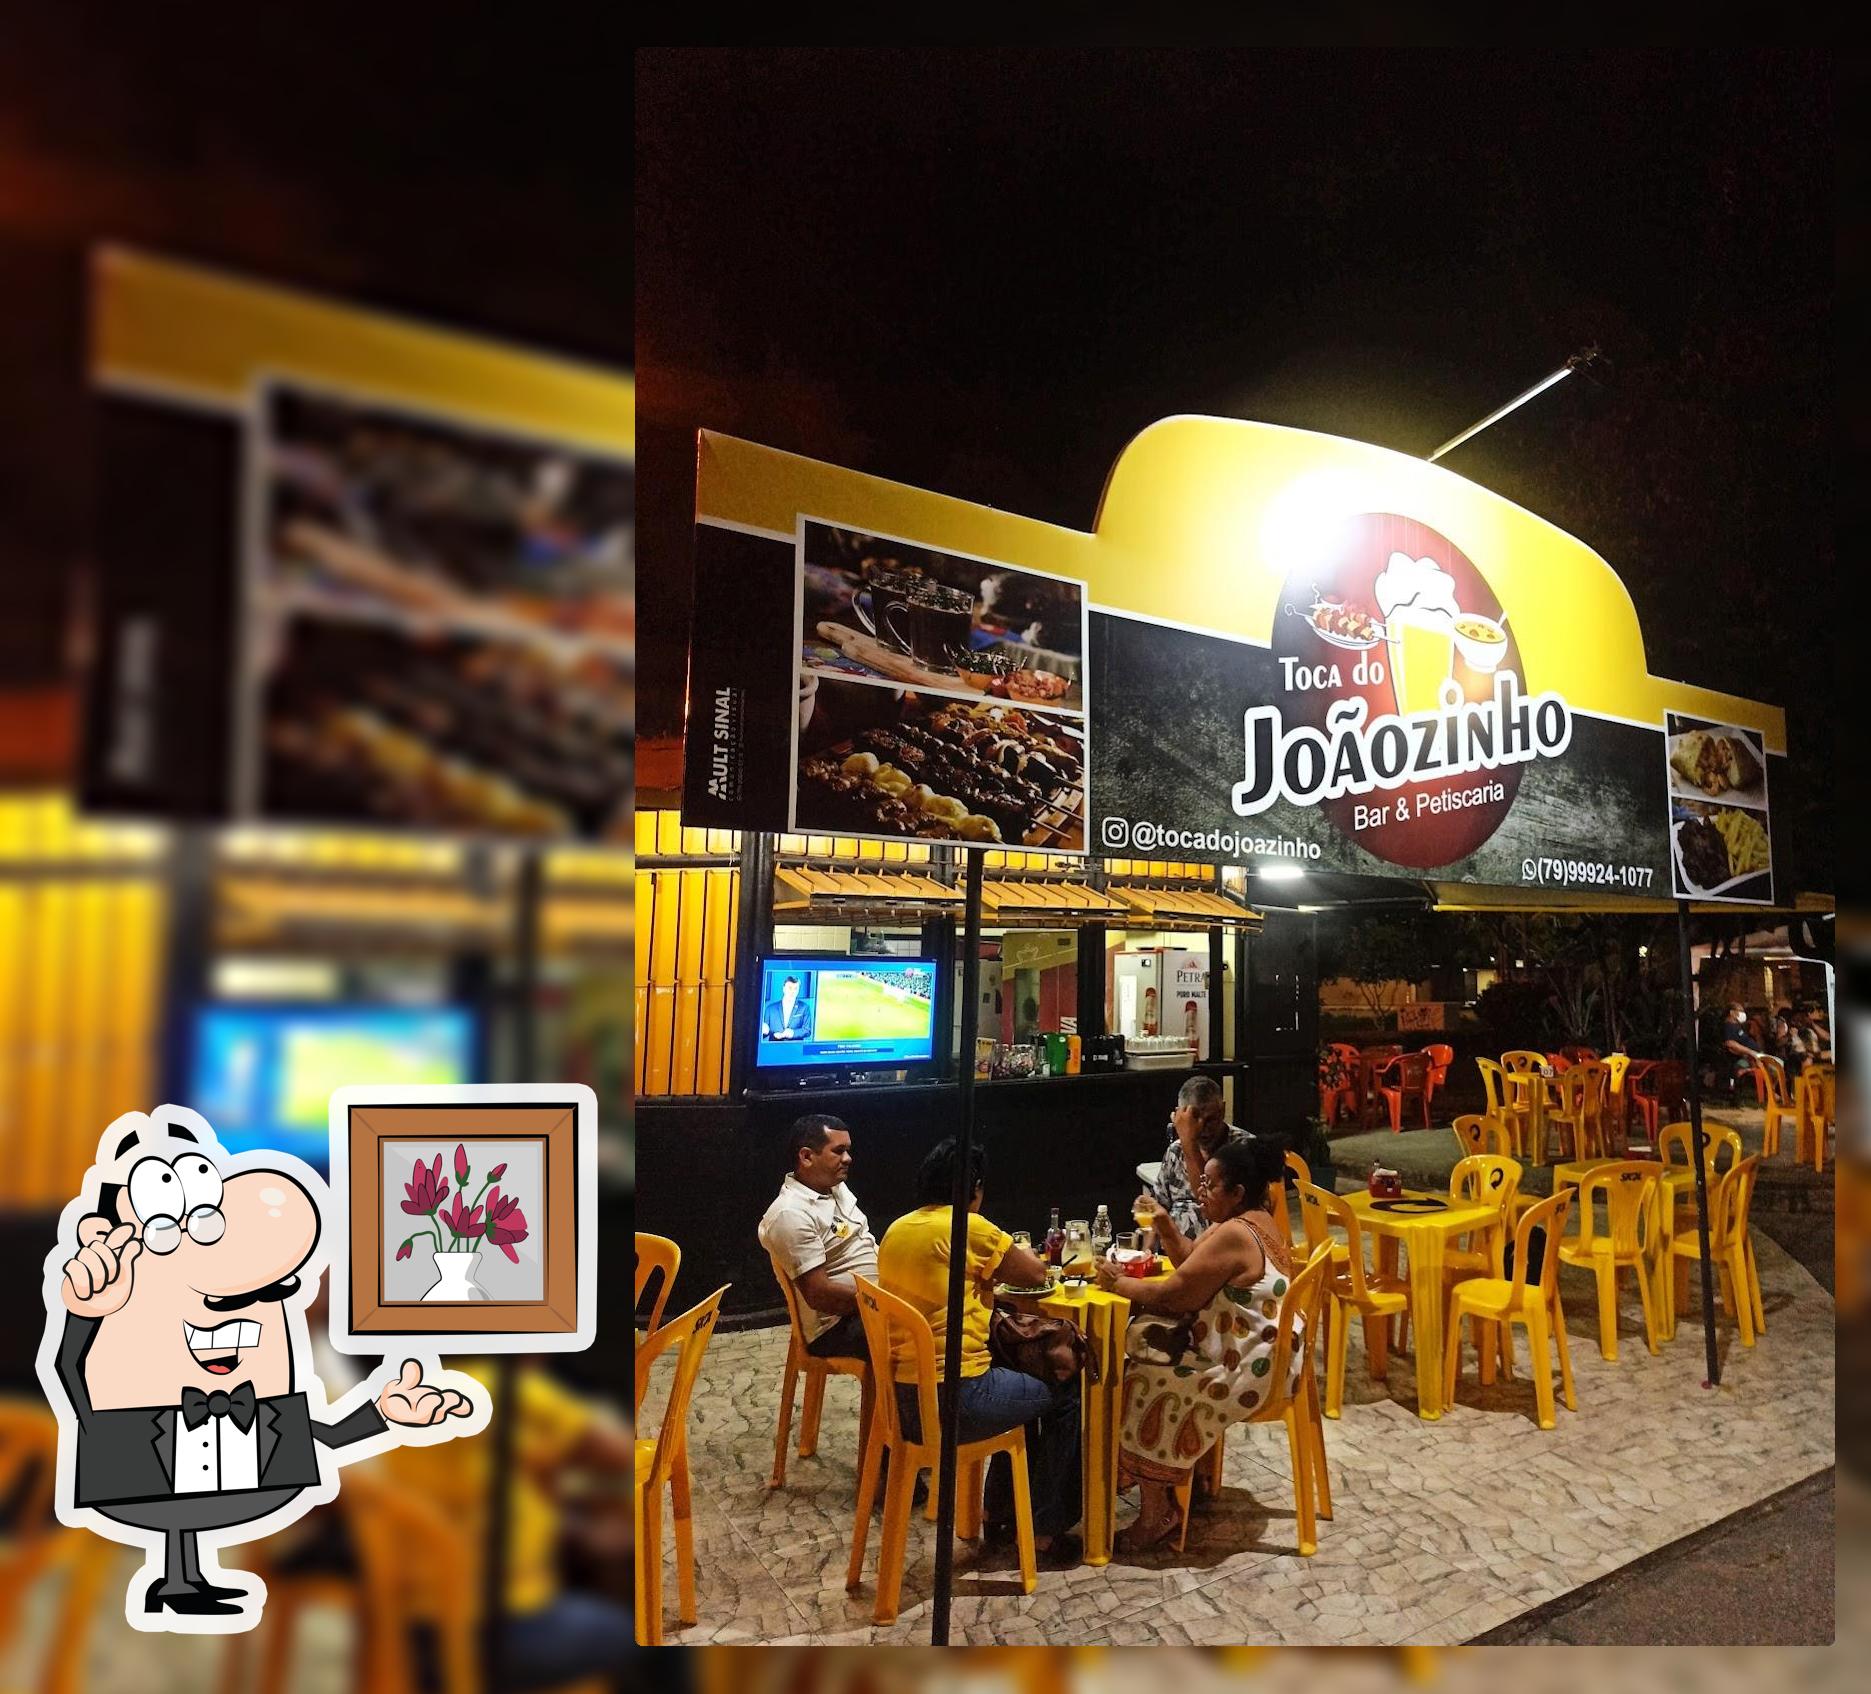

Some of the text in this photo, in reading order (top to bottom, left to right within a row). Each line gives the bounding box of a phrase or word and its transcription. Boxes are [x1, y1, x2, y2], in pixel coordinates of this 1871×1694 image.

[1352, 649, 1385, 687] do
[713, 687, 731, 740] SINAL
[1353, 779, 1505, 831] Bar & Petiscaria
[1131, 821, 1321, 859] @tocadojoazinho
[1537, 857, 1654, 888] (79)99924-1077
